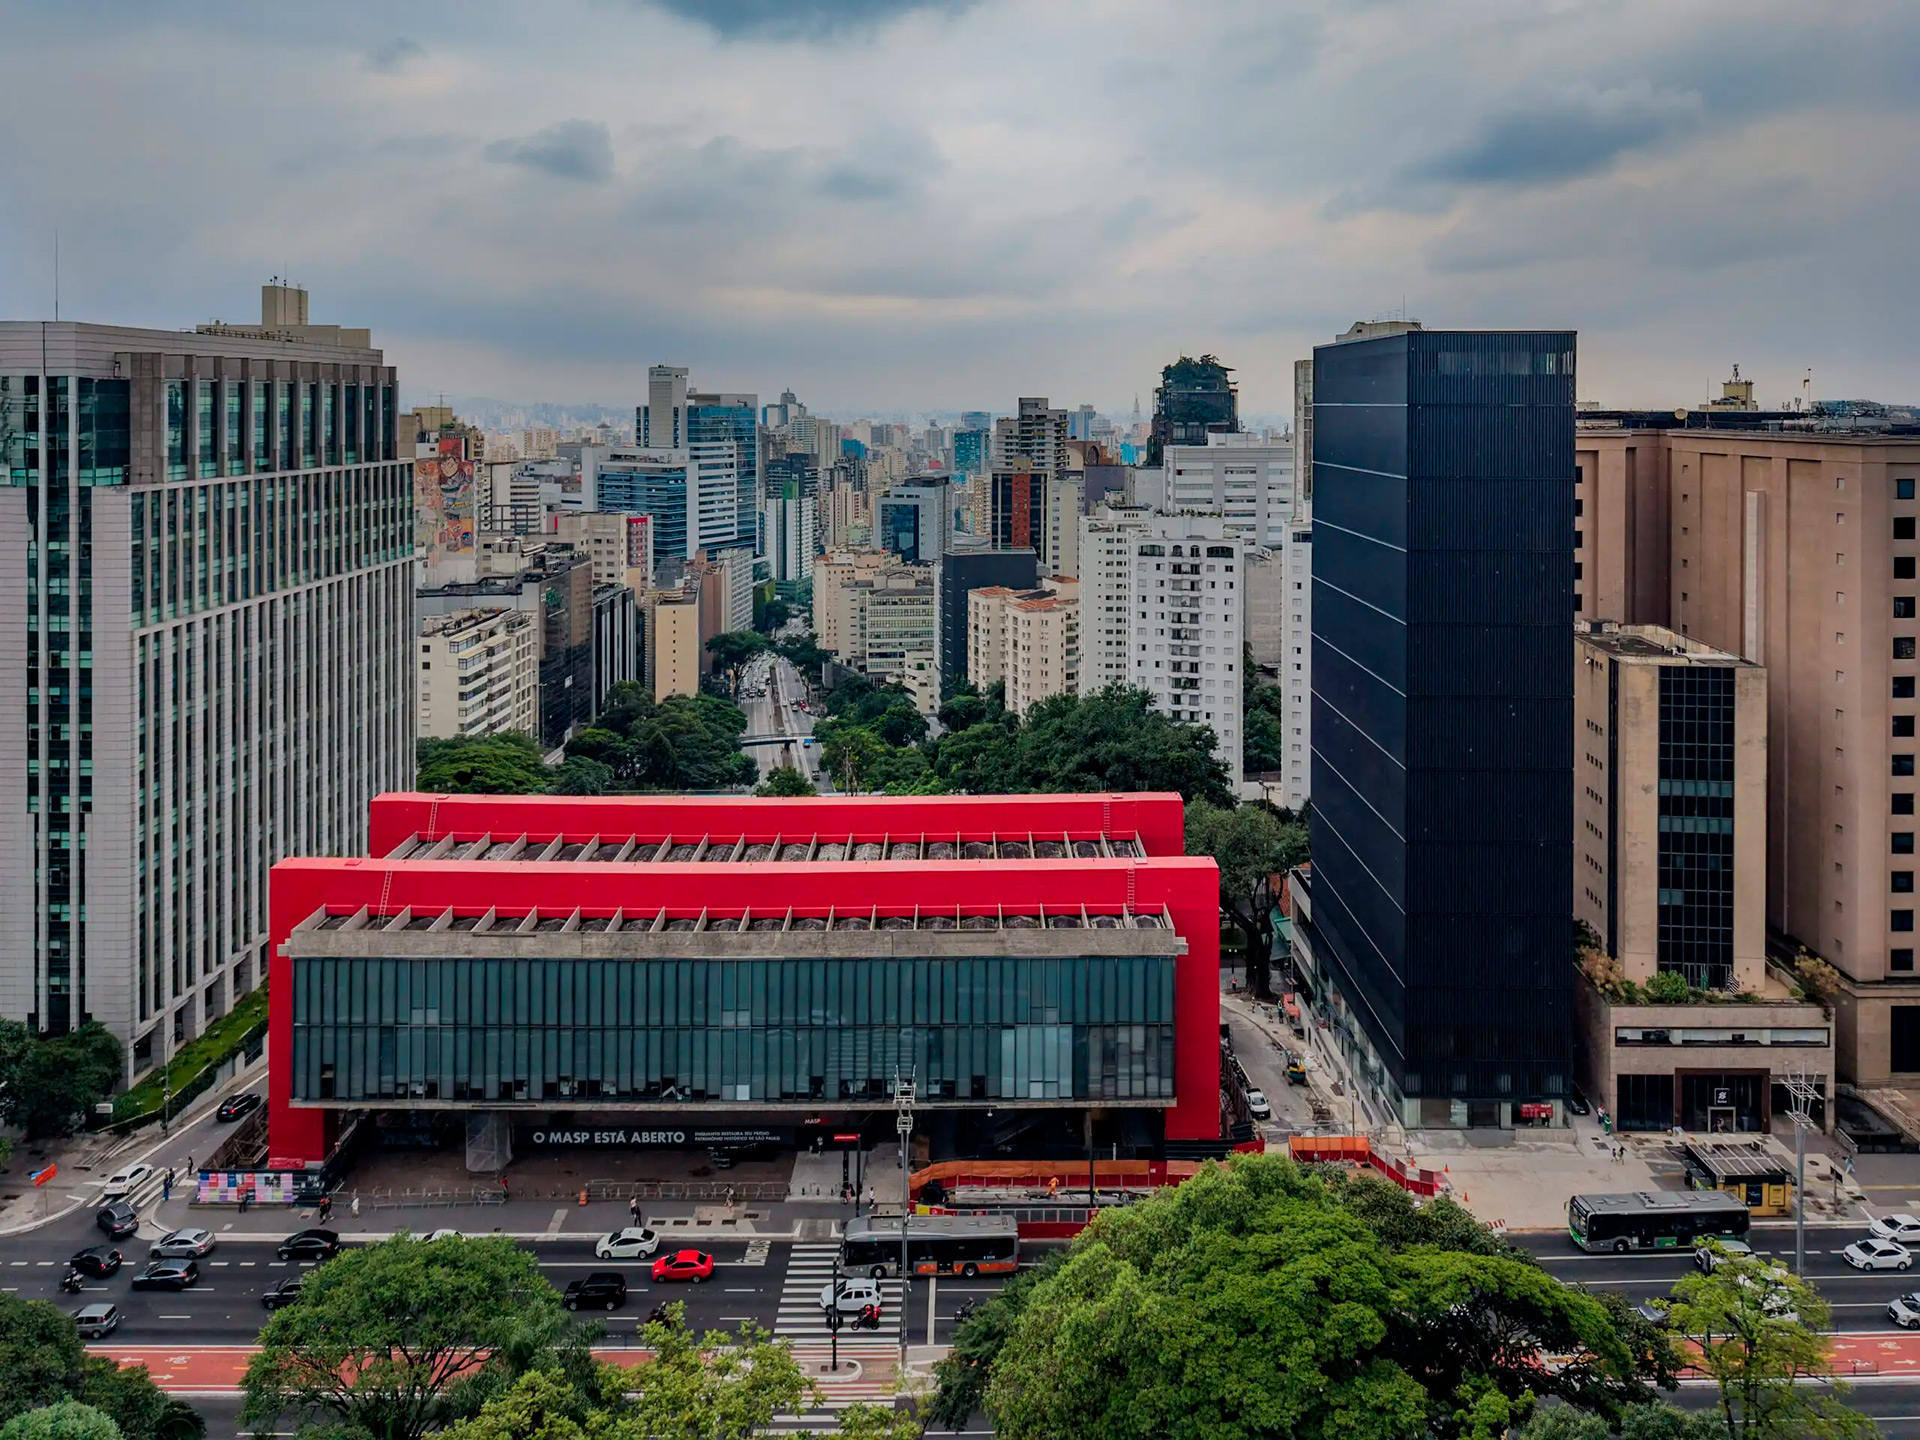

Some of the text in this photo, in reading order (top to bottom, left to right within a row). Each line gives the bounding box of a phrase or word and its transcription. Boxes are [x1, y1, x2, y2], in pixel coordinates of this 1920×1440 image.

[533, 1130, 685, 1144] O MASP ESTÁ ABERTO
